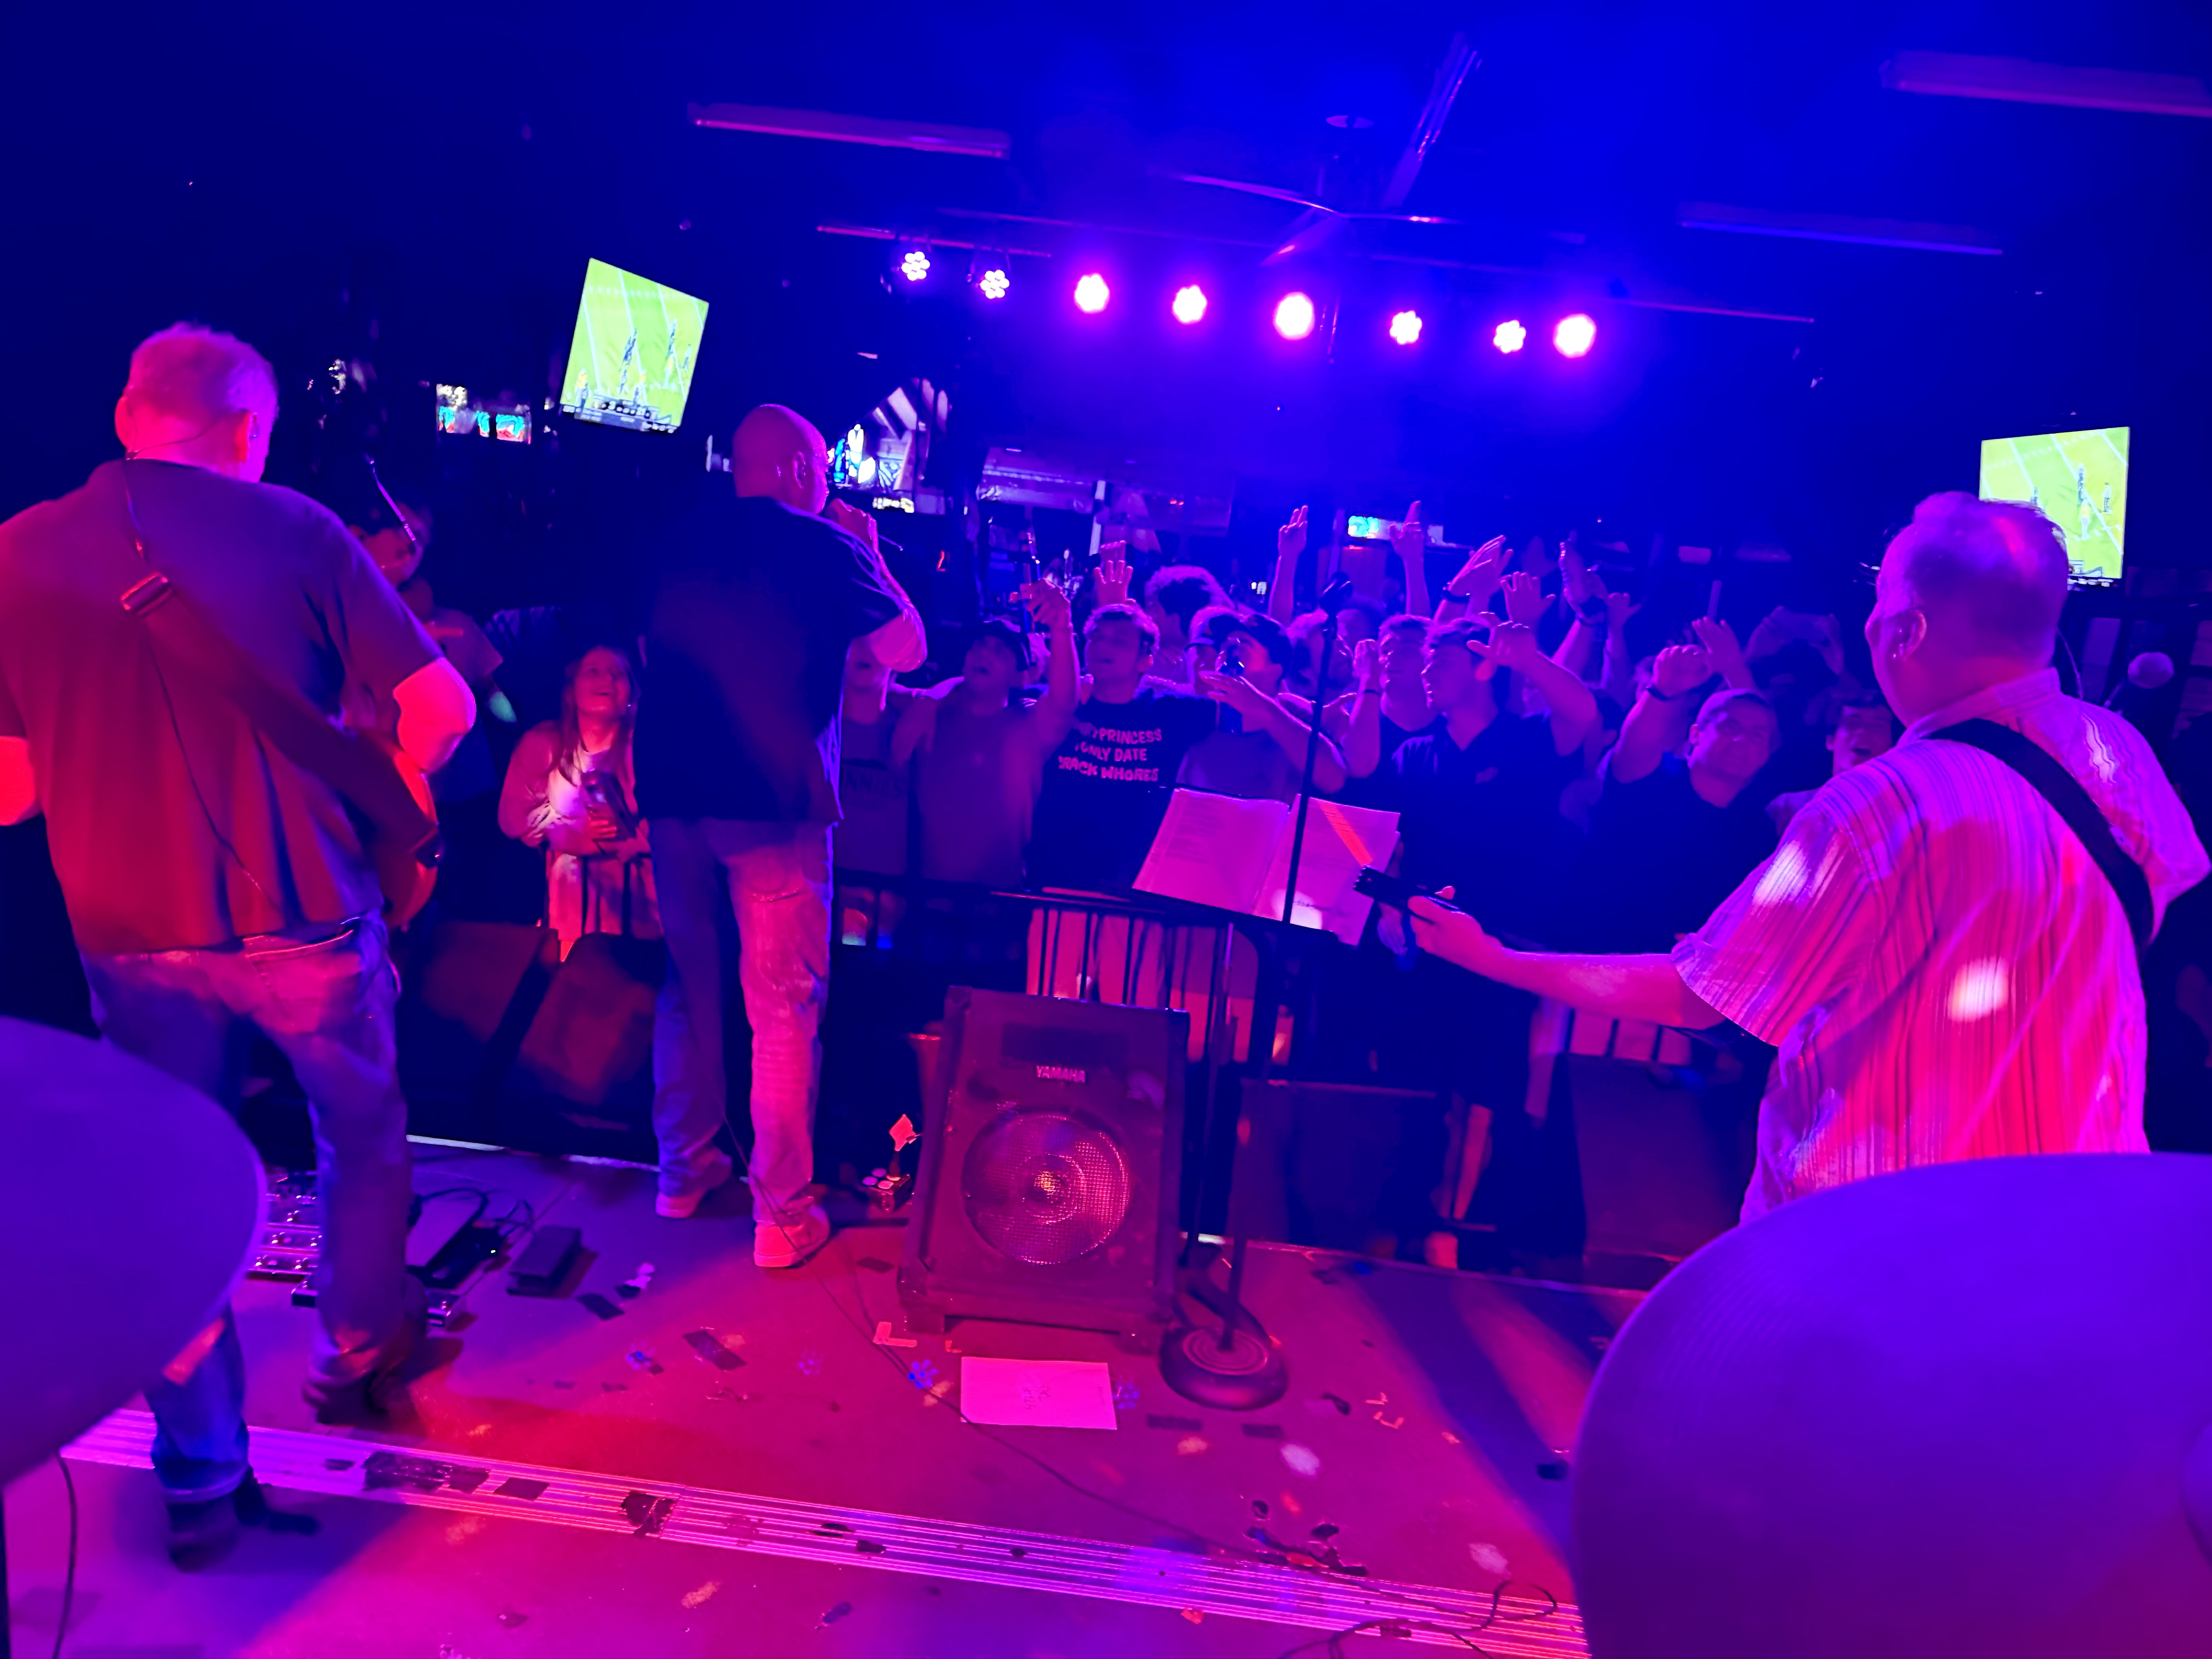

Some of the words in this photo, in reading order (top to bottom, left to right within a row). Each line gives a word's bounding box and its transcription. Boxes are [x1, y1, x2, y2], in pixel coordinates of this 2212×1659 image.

[1099, 728, 1162, 744] PRINCESS
[1080, 741, 1111, 761] ONLY
[1114, 748, 1147, 762] DATE
[1101, 766, 1159, 781] WHORES
[1036, 1065, 1085, 1083] YAMAHA
